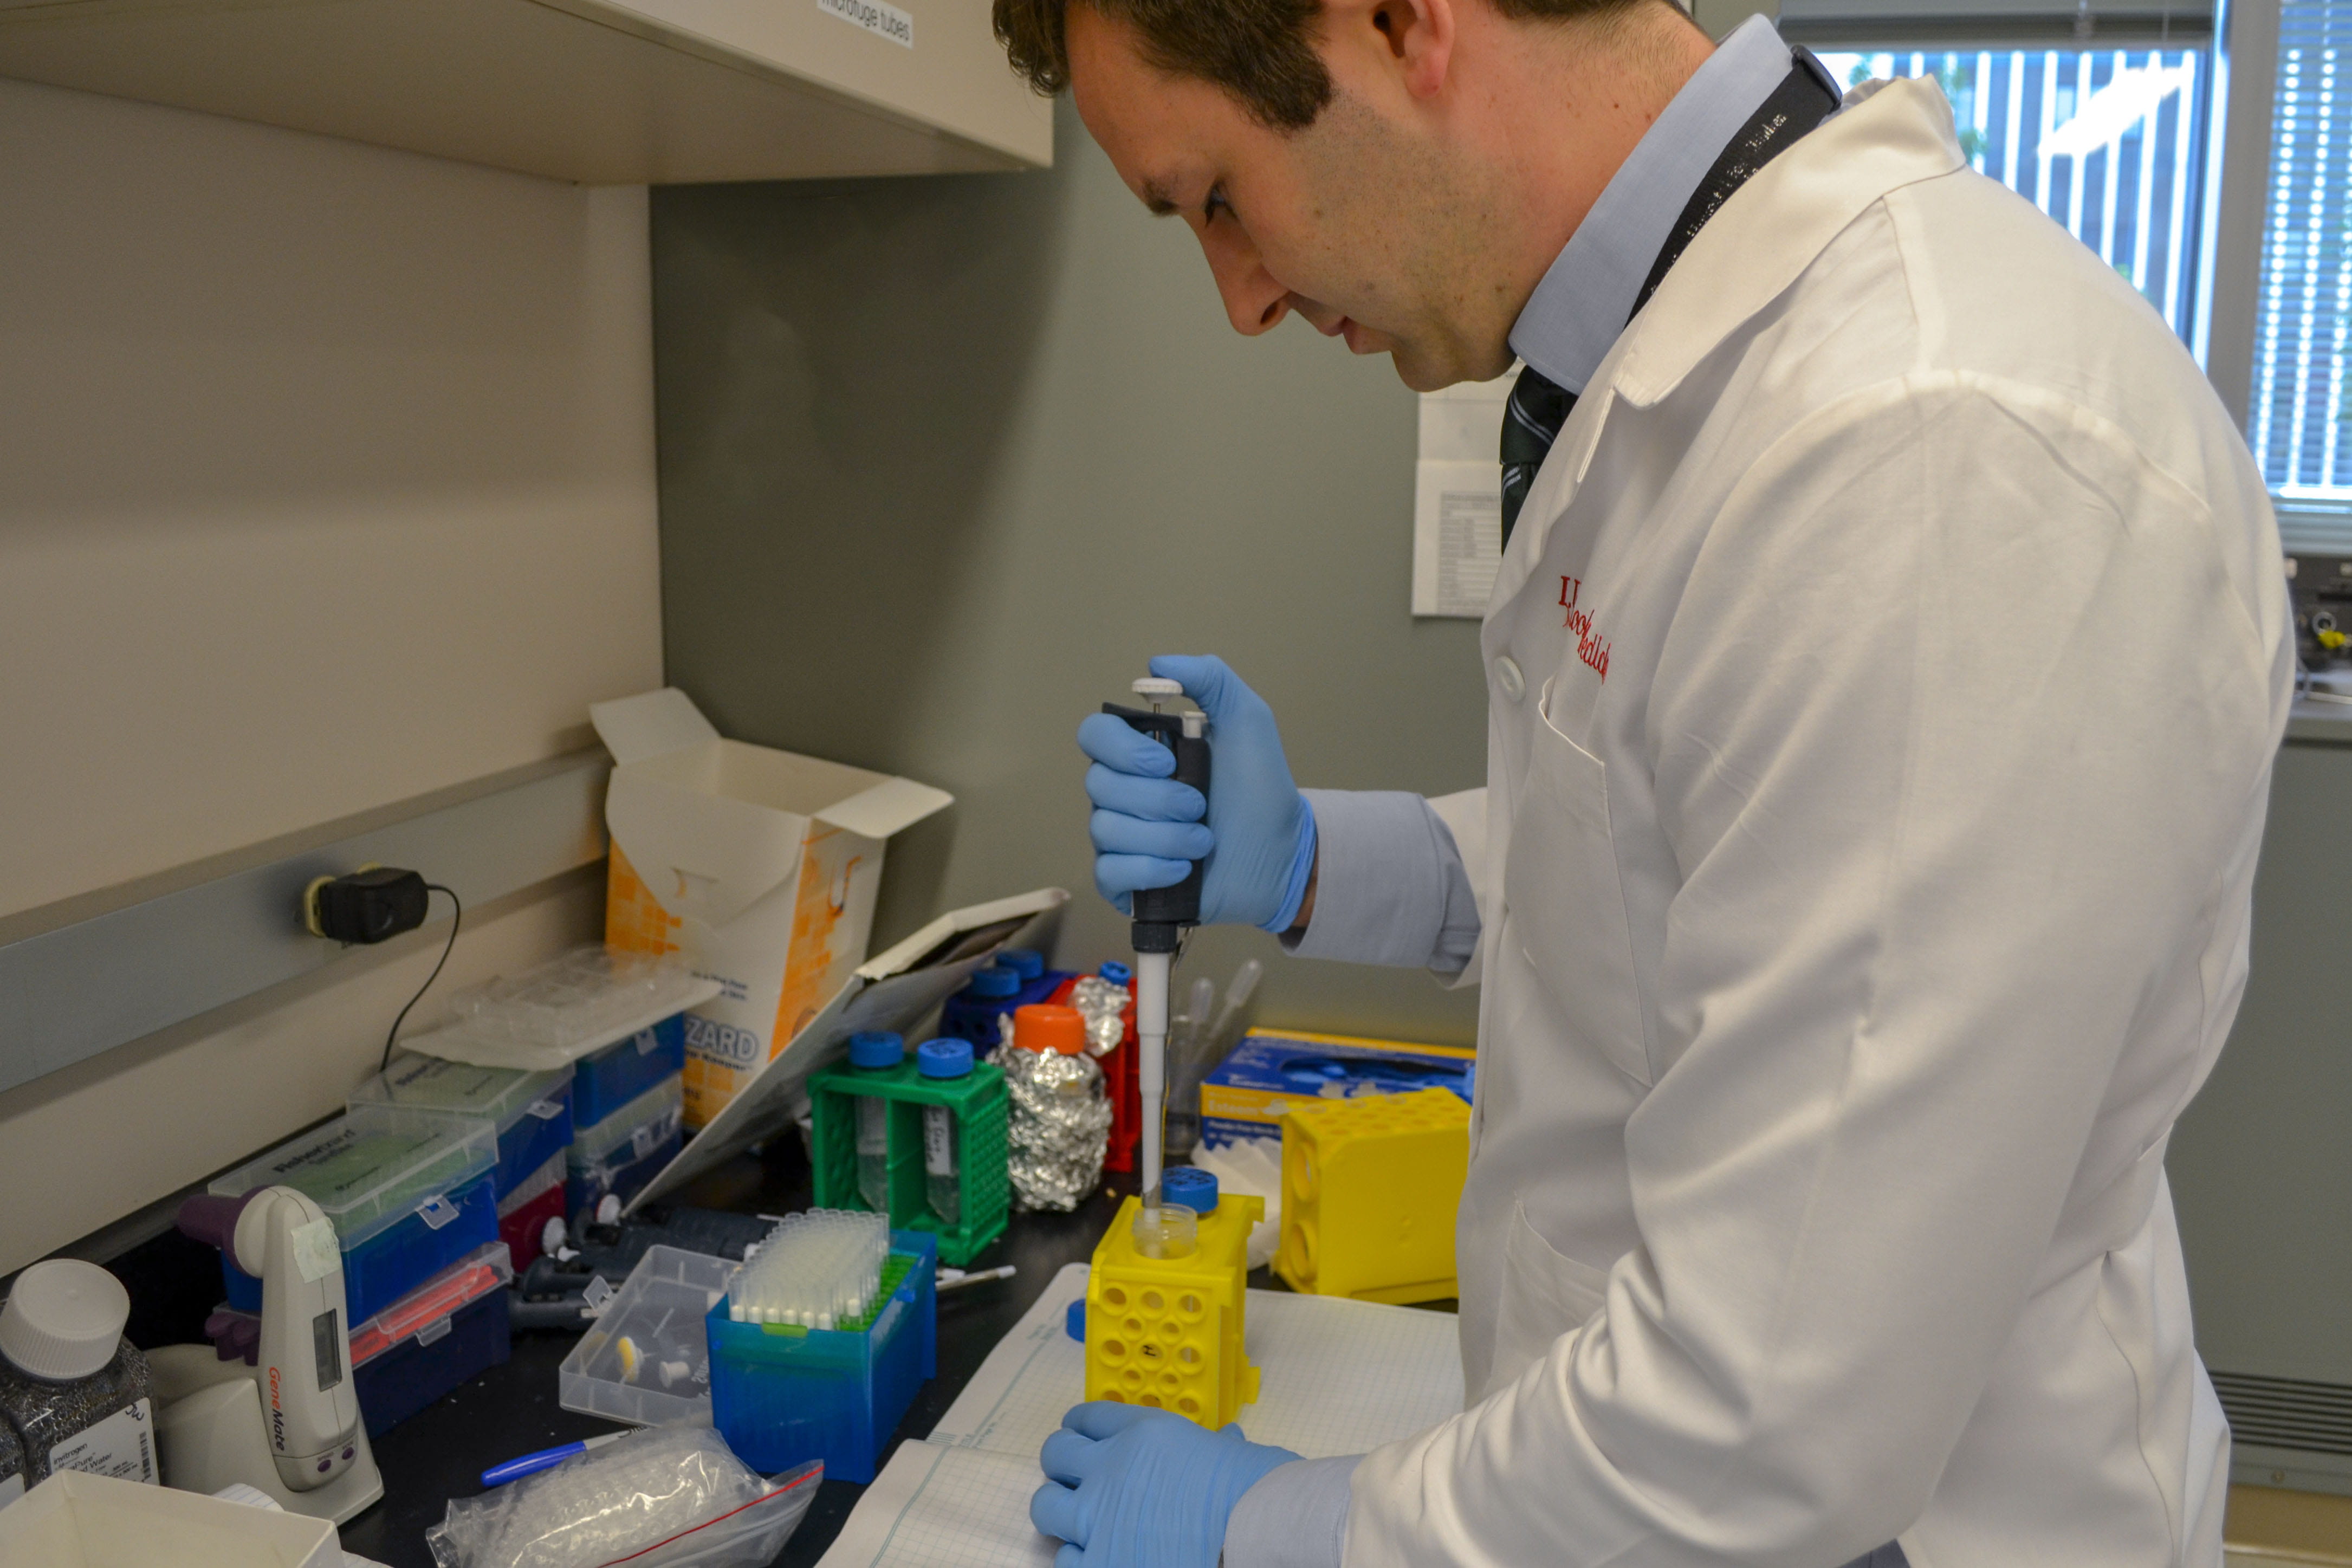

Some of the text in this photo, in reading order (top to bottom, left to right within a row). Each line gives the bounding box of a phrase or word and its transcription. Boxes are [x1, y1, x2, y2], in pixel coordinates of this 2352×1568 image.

[822, 0, 909, 41] crofuge tubes
[684, 1014, 759, 1061] ZARD
[269, 1366, 284, 1452] GeneMate
[54, 1443, 88, 1465] invitrogen
[90, 1453, 113, 1468] Water
